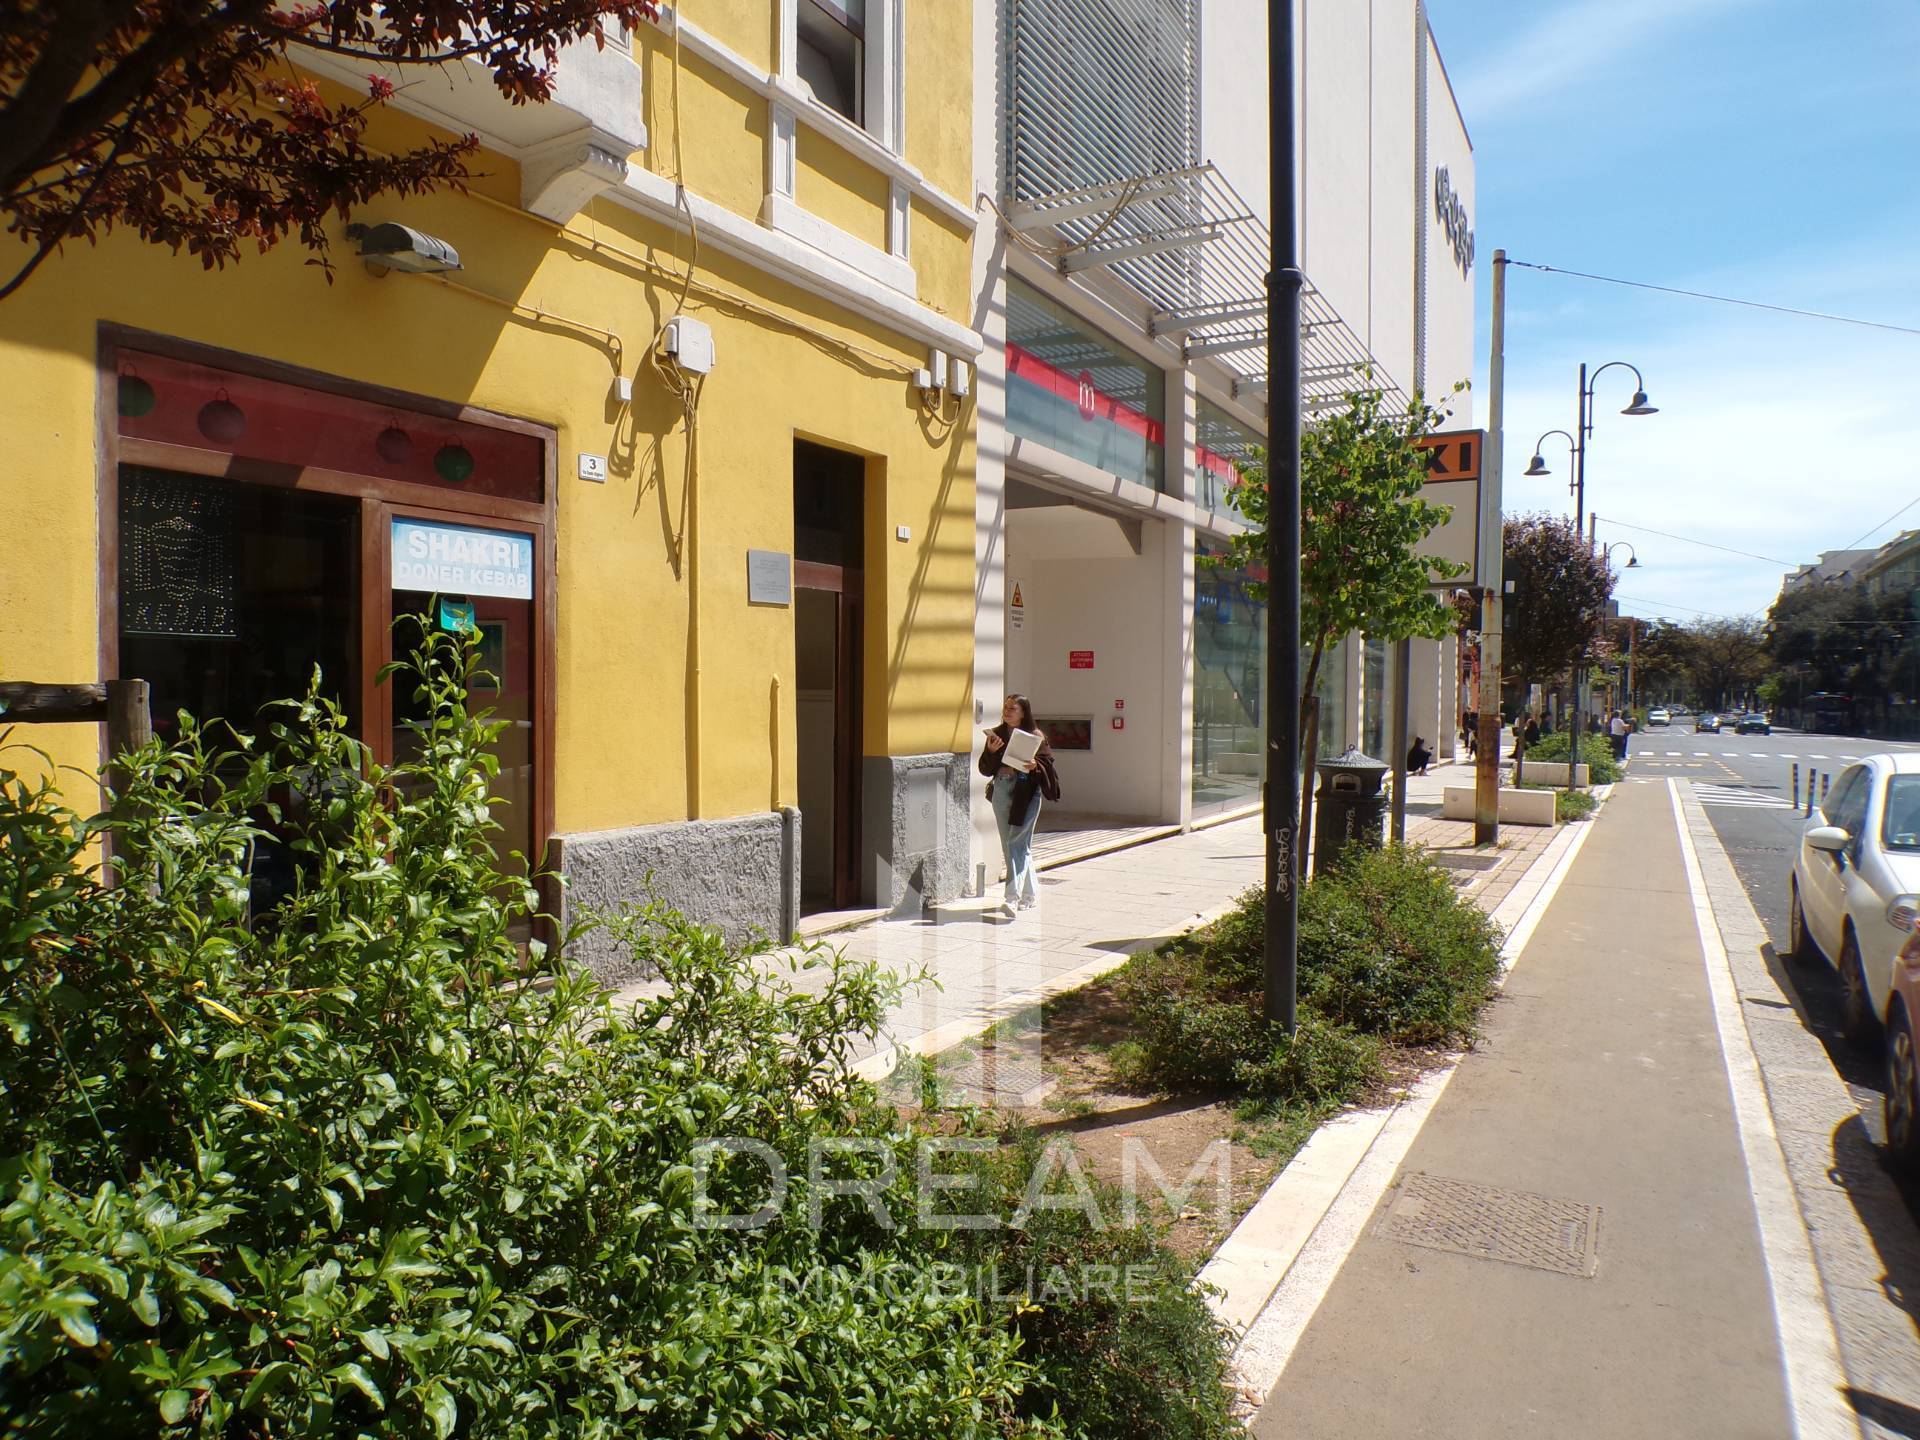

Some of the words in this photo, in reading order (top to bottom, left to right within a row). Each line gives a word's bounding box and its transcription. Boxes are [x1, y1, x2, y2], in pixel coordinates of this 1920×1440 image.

[589, 459, 597, 470] 3
[1412, 441, 1472, 474] XI
[408, 530, 520, 569] SHAKRI
[398, 561, 465, 585] DONER
[470, 568, 529, 589] KEBAB
[134, 601, 228, 627] KEBAB
